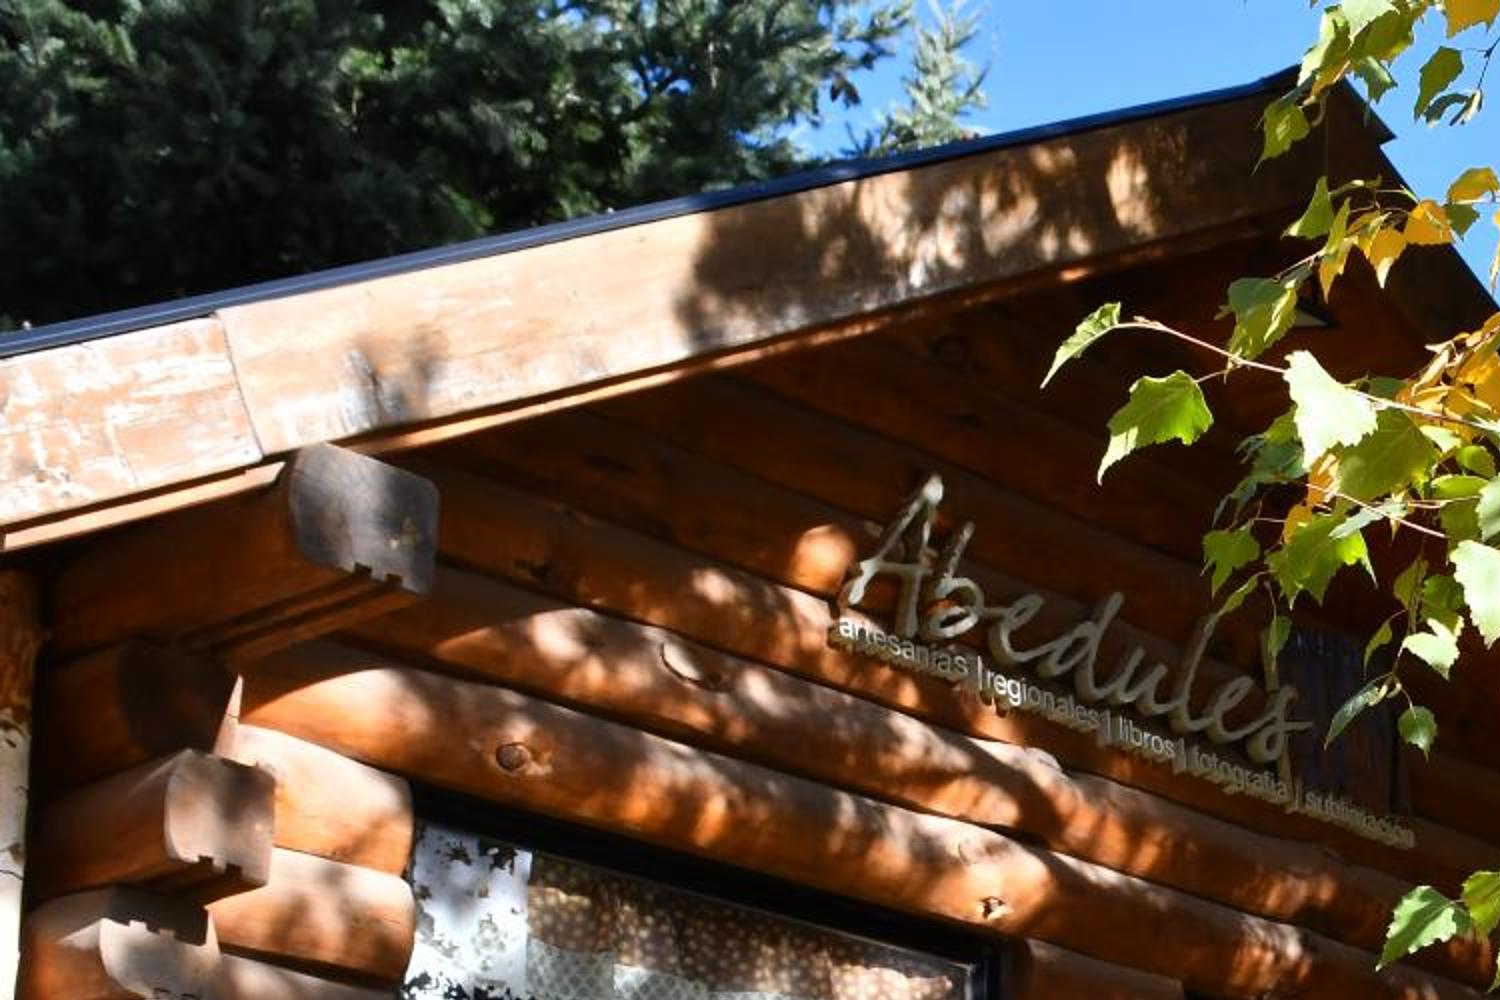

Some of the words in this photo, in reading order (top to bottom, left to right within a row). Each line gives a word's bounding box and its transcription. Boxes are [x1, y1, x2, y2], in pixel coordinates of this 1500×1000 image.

[847, 474, 1312, 762] Abedules
[986, 669, 1099, 724] regionales
[1119, 715, 1175, 757] libros
